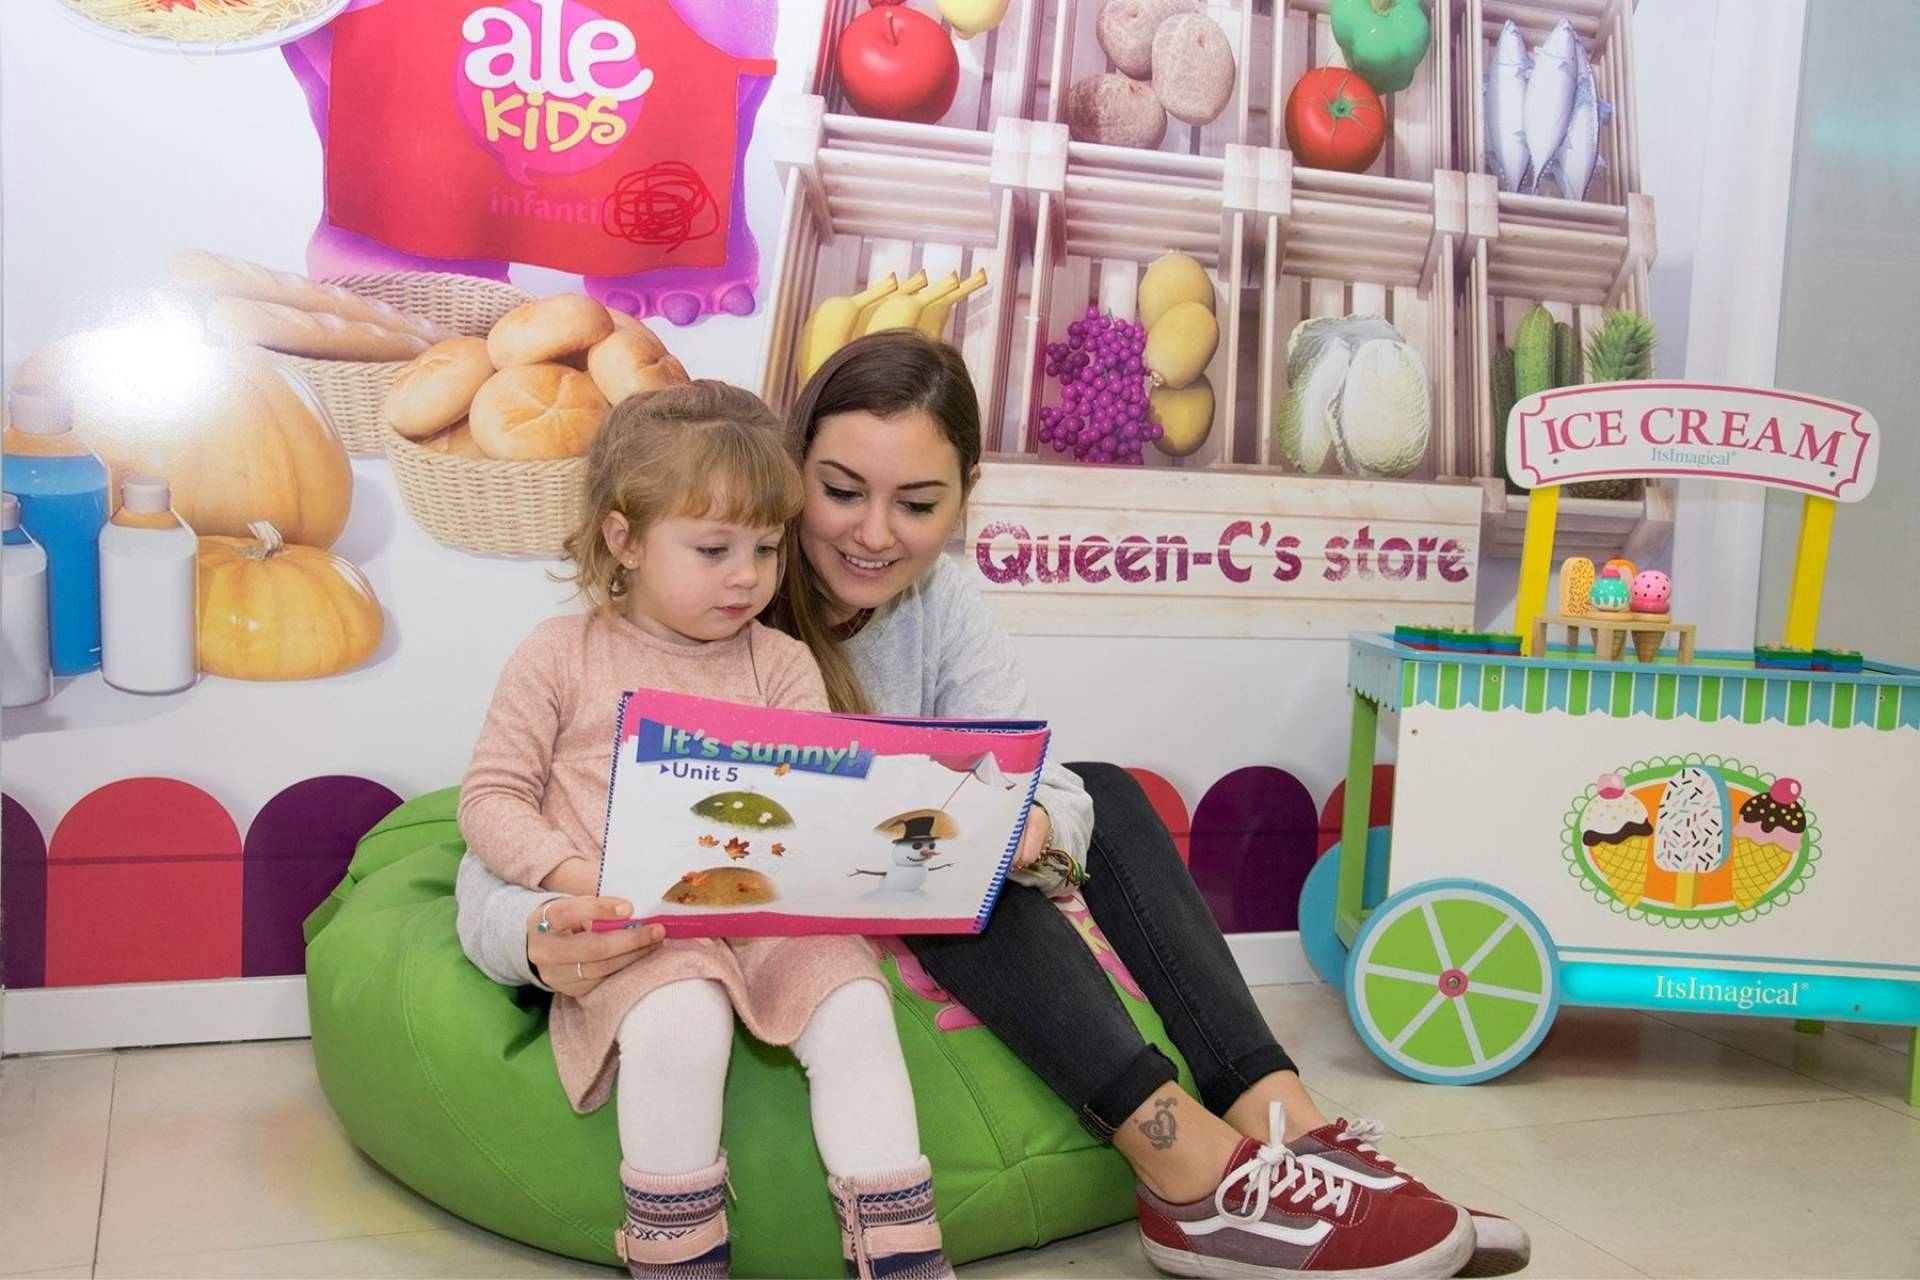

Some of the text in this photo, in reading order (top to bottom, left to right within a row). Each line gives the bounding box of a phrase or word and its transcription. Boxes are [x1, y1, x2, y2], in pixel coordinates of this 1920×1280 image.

[462, 0, 654, 101] ale
[1540, 406, 1847, 468] ICE CREAM
[976, 520, 1470, 587] Queen-C's store
[661, 725, 860, 775] It's sunny!
[672, 762, 739, 783] Unit 5
